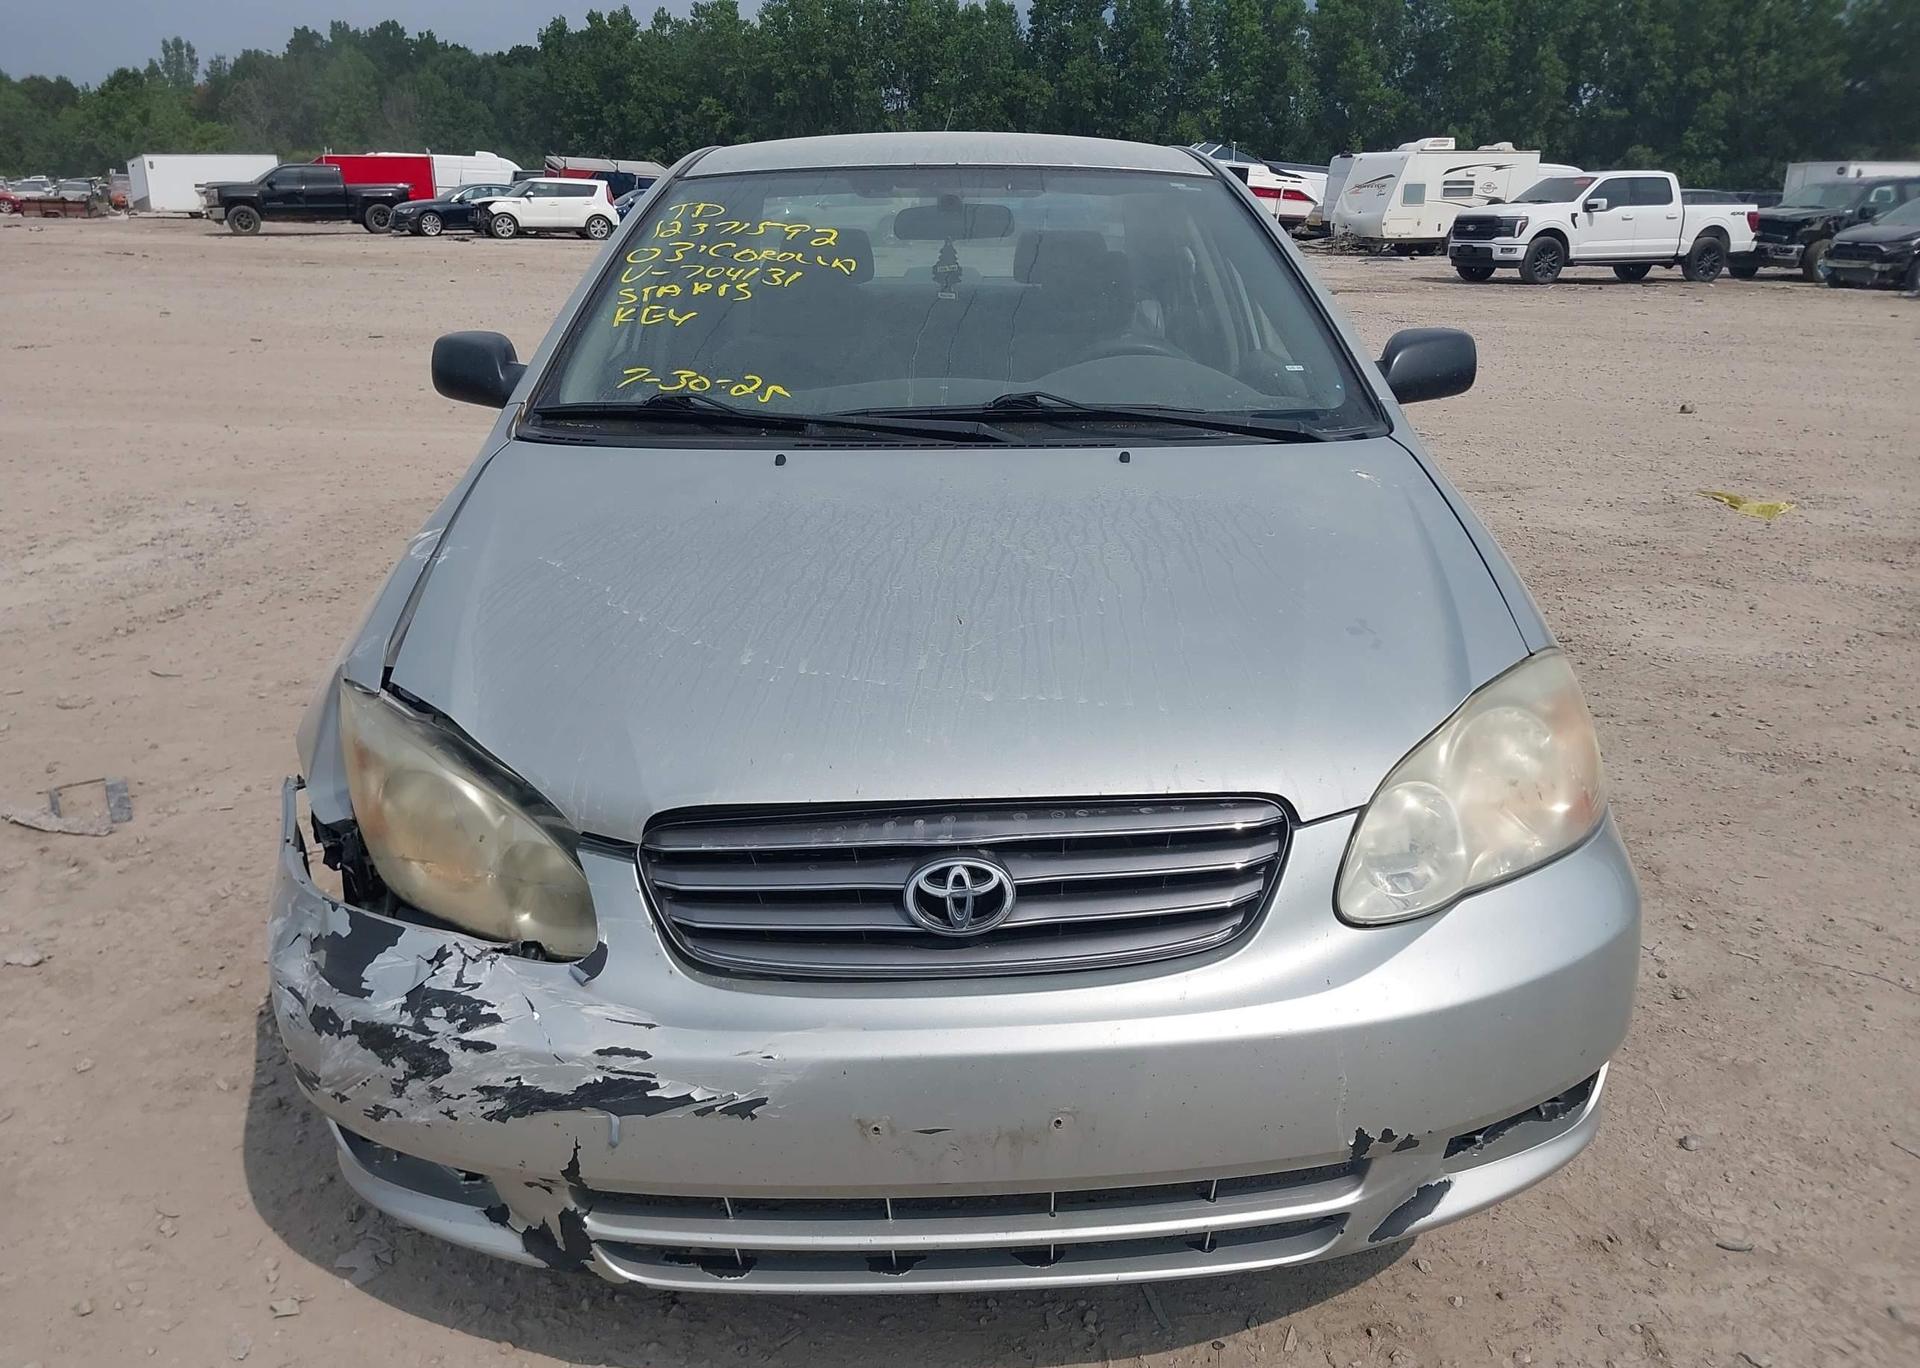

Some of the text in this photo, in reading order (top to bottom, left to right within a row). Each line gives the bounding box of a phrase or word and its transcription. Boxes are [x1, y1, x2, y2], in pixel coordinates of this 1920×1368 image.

[668, 203, 726, 220] TD
[613, 305, 698, 328] KEY
[616, 367, 792, 403] 7-30-25
